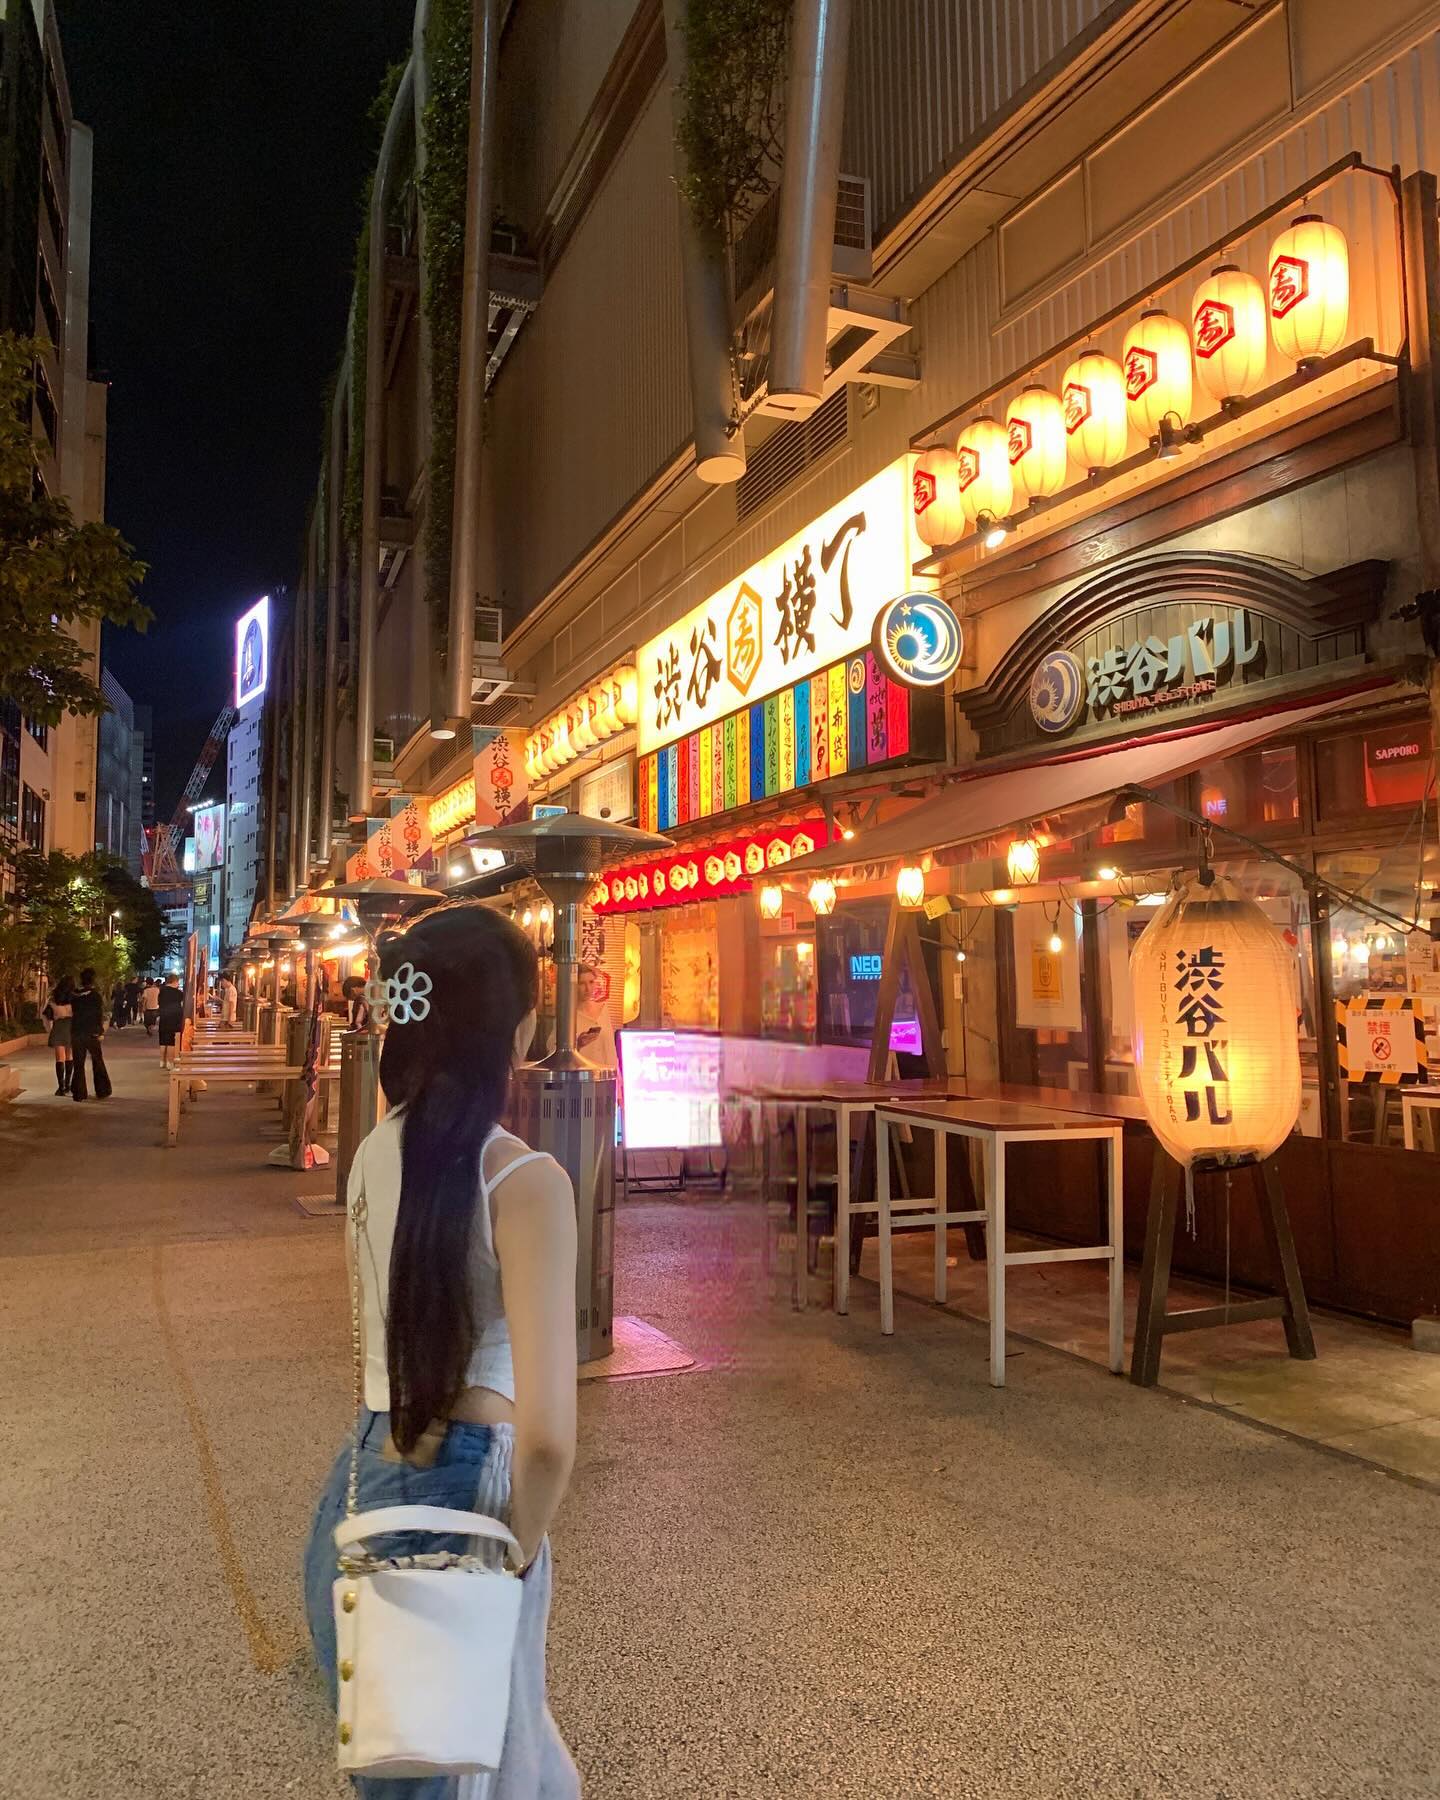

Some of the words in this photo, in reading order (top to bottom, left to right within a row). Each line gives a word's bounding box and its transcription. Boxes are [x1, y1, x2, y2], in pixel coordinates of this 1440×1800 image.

[1086, 608, 1261, 706] 渋谷バル
[1113, 695, 1153, 714] SHIBUYA
[1375, 744, 1419, 760] SAPPORO
[852, 955, 881, 972] NEO
[1159, 951, 1169, 1024] SHIBUYA
[1174, 945, 1233, 1126] 渋谷バル
[1367, 1020, 1392, 1036] 禁煙
